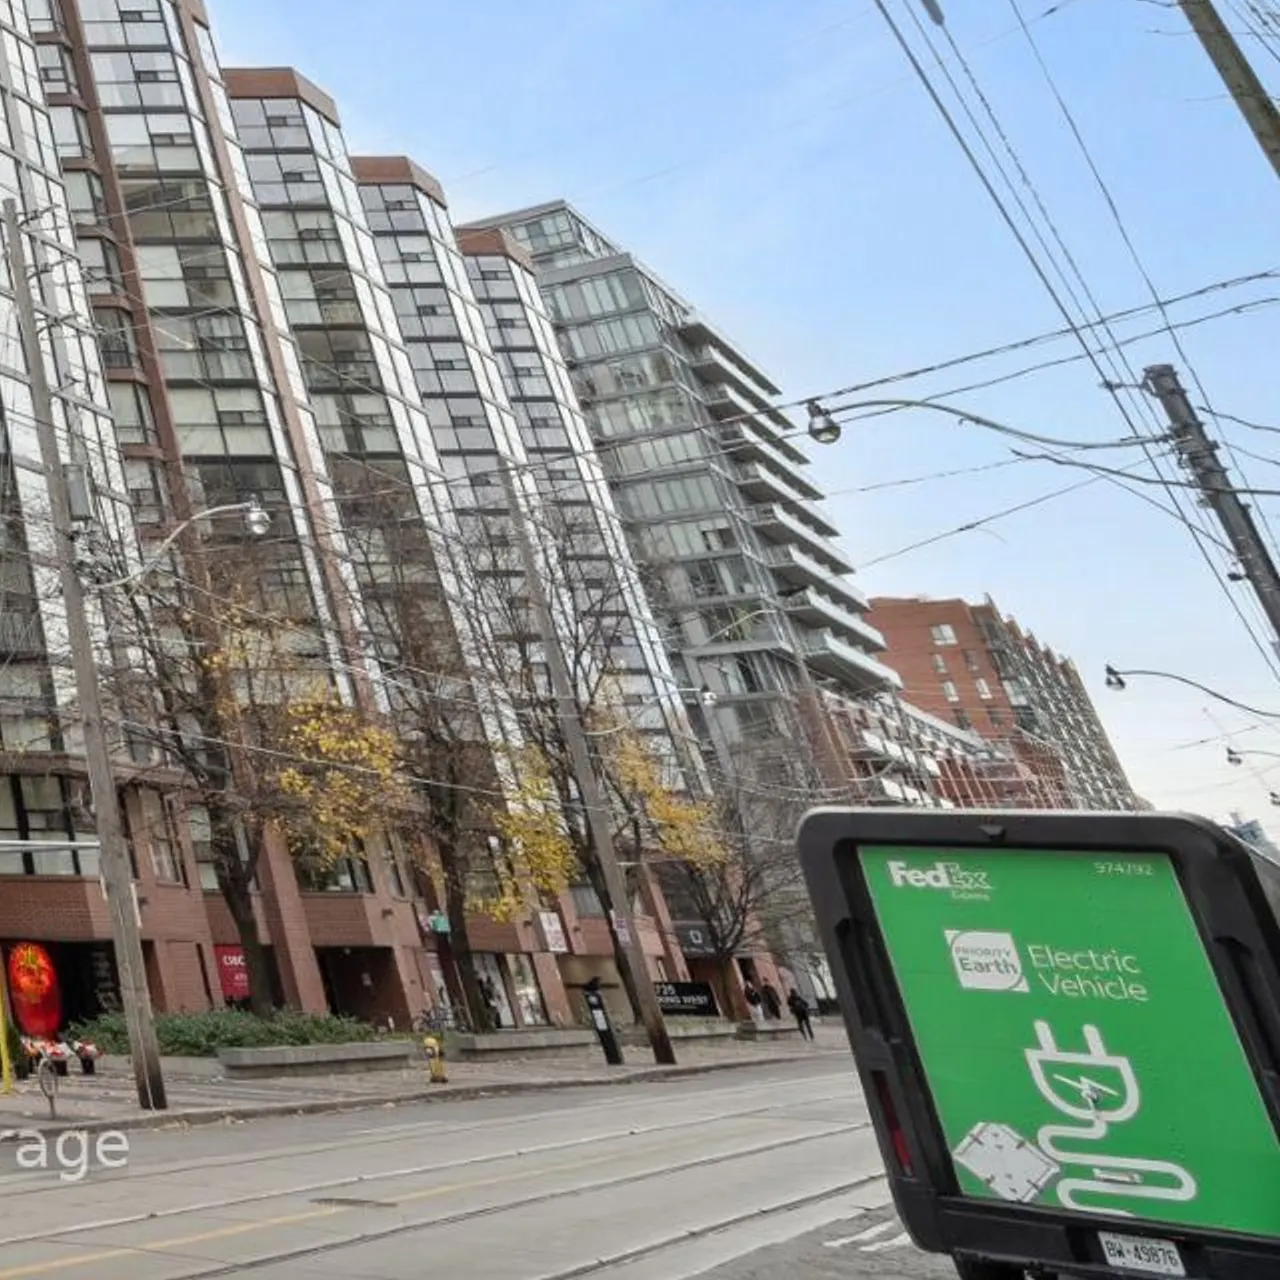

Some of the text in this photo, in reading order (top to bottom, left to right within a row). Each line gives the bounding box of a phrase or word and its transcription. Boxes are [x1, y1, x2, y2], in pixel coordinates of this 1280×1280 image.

[888, 861, 997, 890] FedEx
[954, 945, 1013, 958] PRIORITY
[1027, 944, 1142, 974] Electric
[959, 957, 1019, 976] Earth
[1038, 973, 1150, 1002] Vehicle
